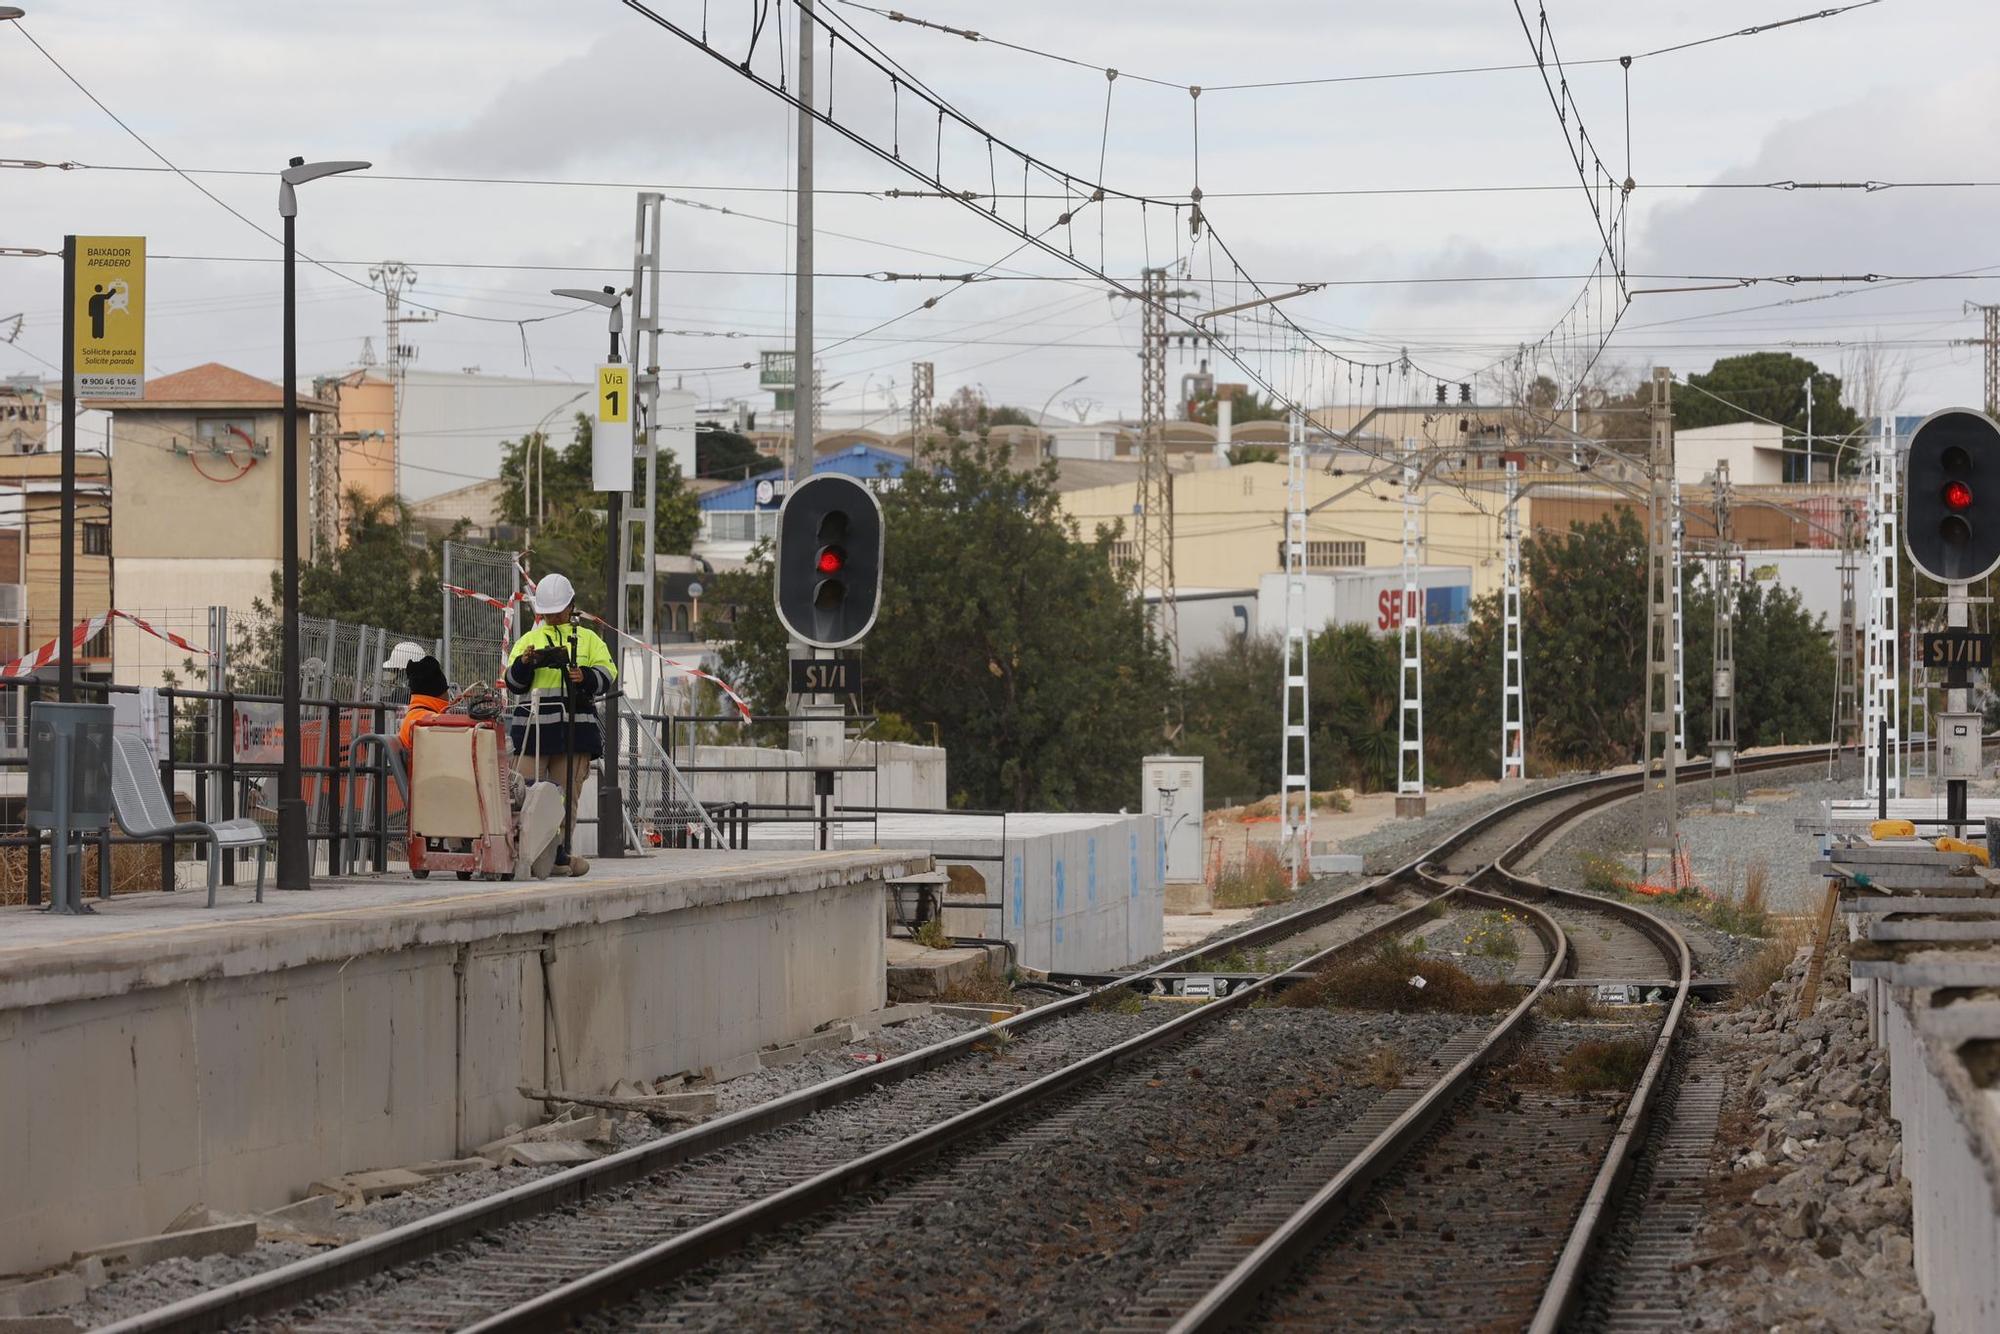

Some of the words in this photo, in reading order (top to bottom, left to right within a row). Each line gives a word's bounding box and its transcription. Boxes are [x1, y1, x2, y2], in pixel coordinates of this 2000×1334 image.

[87, 248, 131, 256] BAIXADOR
[87, 259, 131, 267] APEADERO
[111, 349, 137, 357] parada
[85, 357, 109, 365] Solicite
[109, 358, 135, 366] parada
[89, 378, 104, 386] 900
[105, 378, 115, 386] 46
[116, 378, 126, 386] 10
[127, 378, 137, 386] 46
[605, 391, 619, 416] 1
